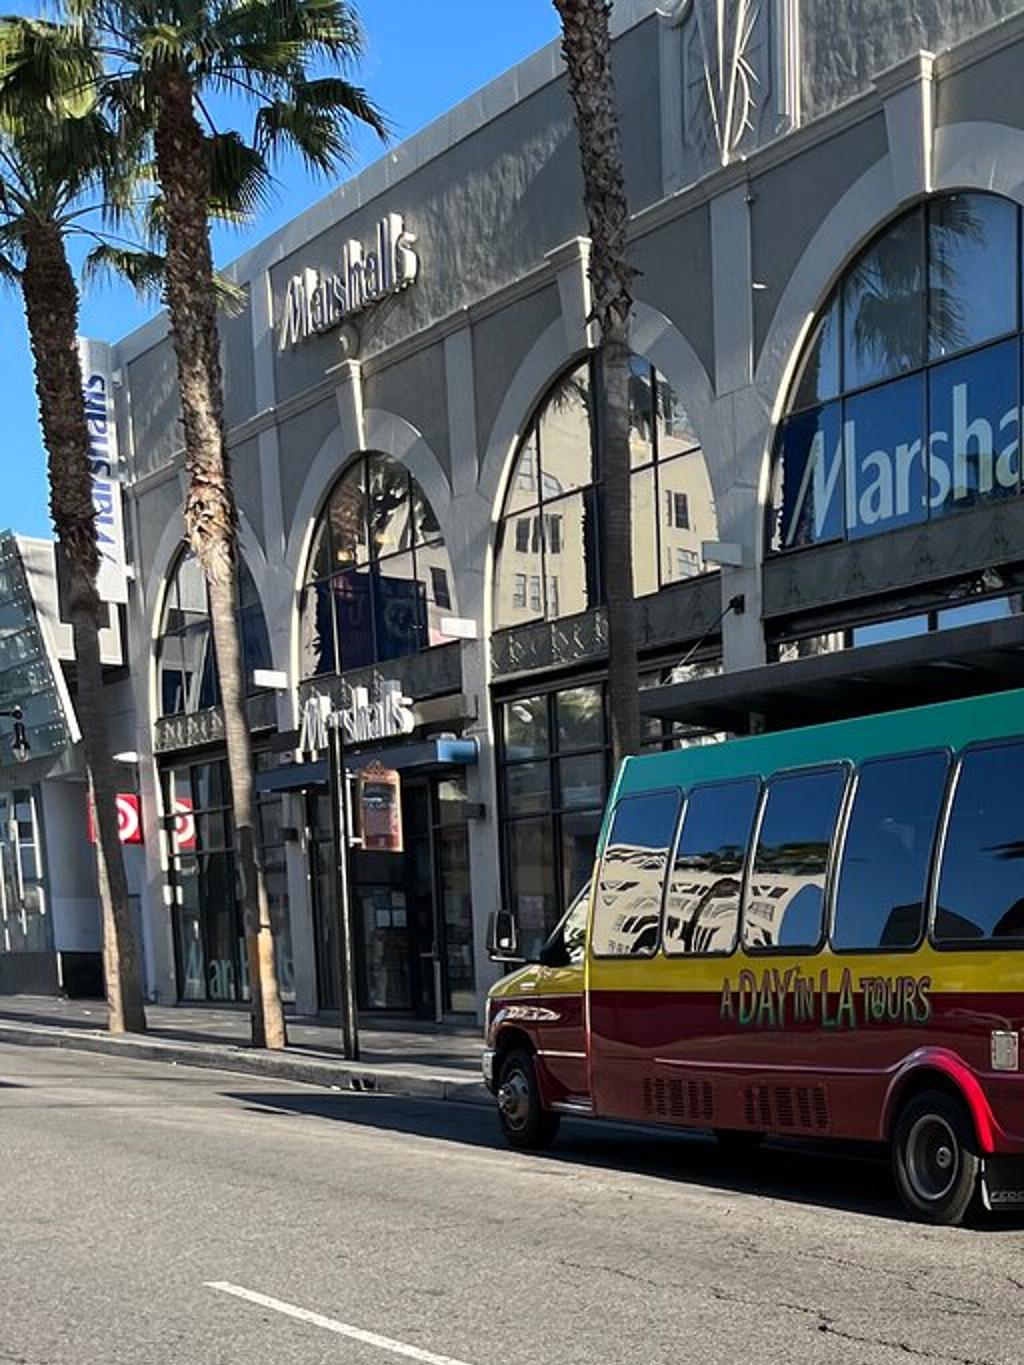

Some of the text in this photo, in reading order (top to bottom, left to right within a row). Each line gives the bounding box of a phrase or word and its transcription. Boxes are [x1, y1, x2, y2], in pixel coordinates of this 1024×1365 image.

[278, 211, 418, 350] Marshalls
[720, 977, 735, 1021] A
[738, 966, 794, 1026] DAY
[819, 966, 858, 1028] LA
[860, 975, 932, 1023] TOURS
